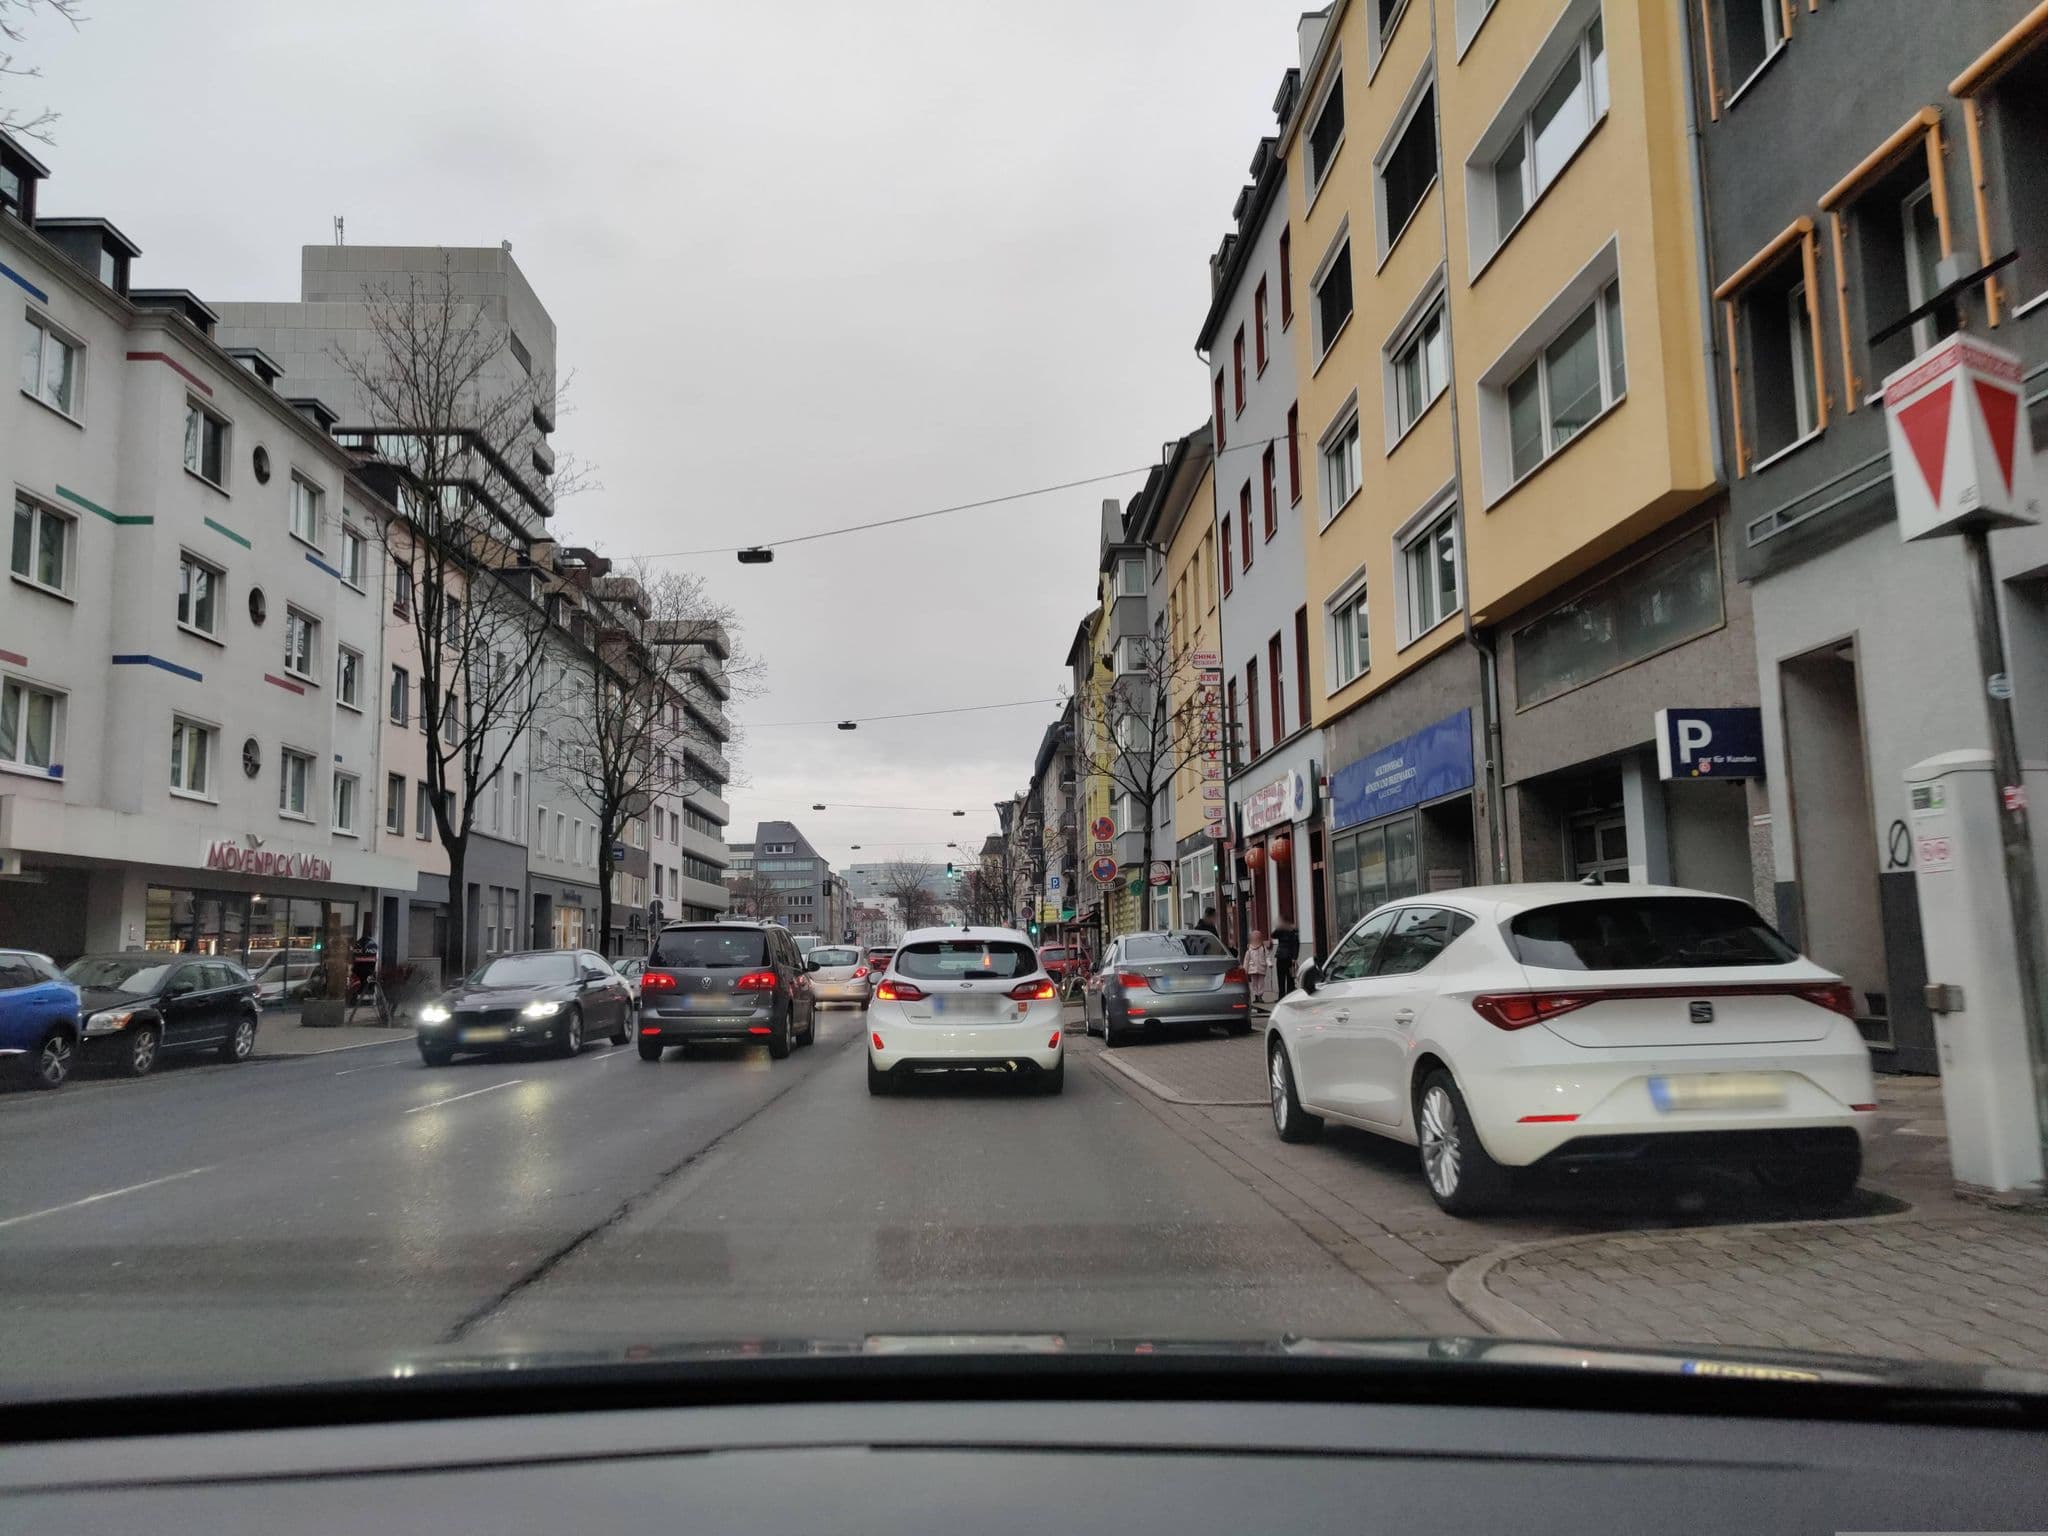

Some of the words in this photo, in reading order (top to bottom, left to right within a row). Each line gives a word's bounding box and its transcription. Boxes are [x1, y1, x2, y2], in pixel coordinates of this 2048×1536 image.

[1199, 674, 1219, 682] NEW
[1678, 719, 1713, 763] P
[1726, 755, 1757, 763] Kunden
[207, 840, 294, 877] MÖVENPICK
[299, 853, 332, 881] WEIN
